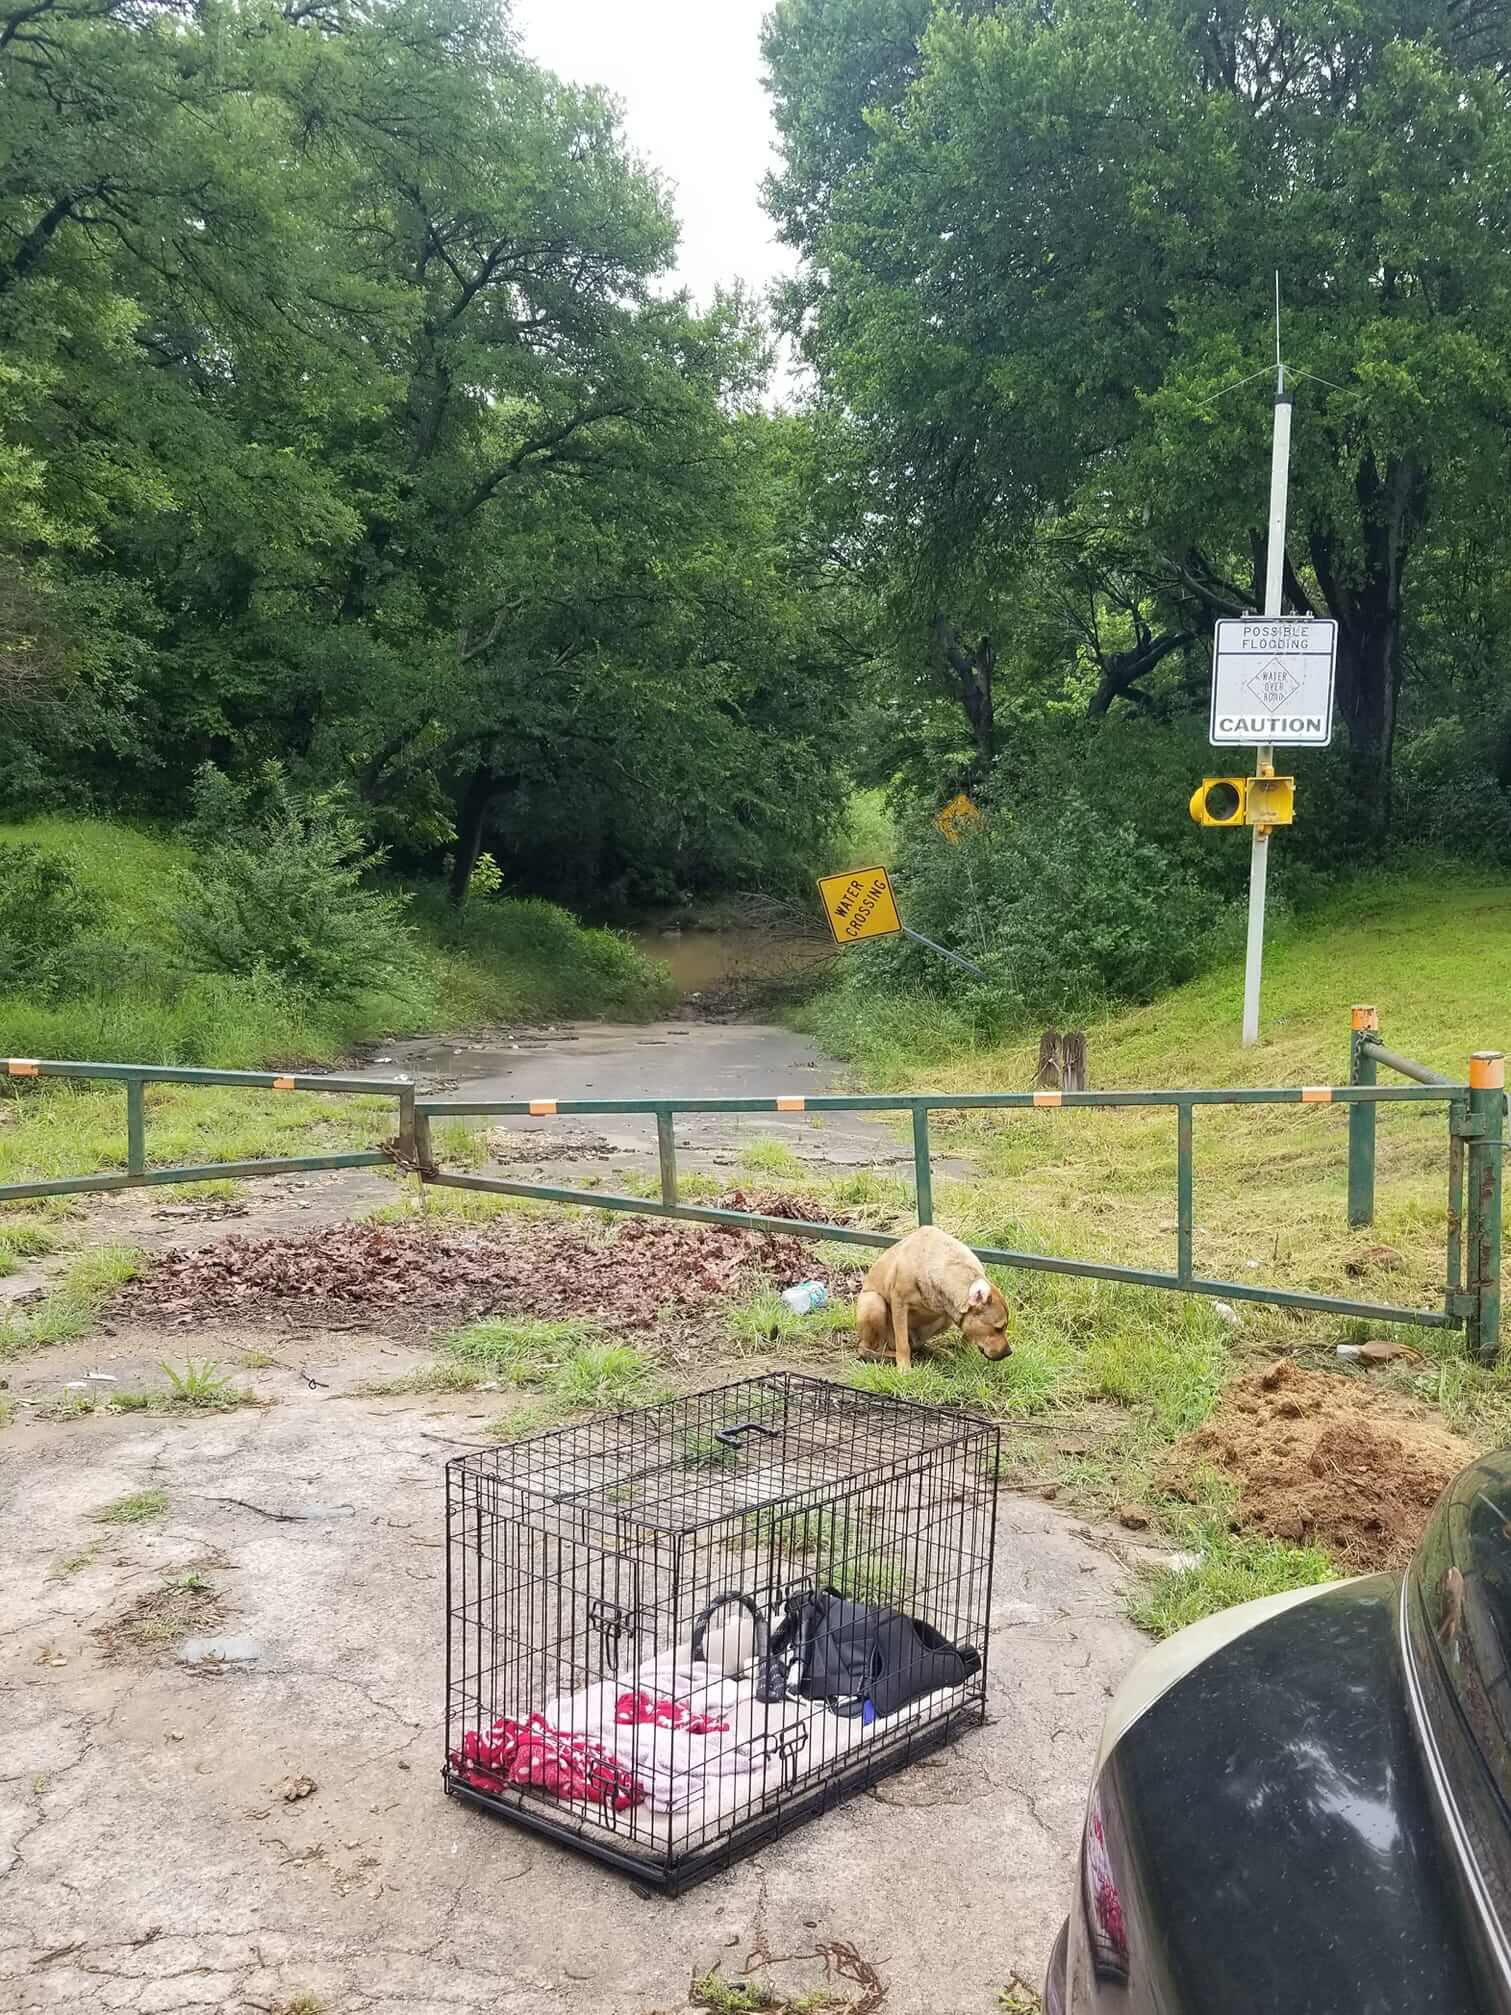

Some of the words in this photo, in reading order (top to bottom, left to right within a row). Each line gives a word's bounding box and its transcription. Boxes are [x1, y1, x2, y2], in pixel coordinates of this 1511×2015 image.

[1243, 626, 1310, 637] POSSIBLE
[1242, 639, 1309, 649] FLOODING
[1262, 671, 1287, 681] WATER
[1219, 718, 1321, 733] CAUTION
[834, 880, 865, 919] WATER
[846, 879, 887, 937] CROSSING
